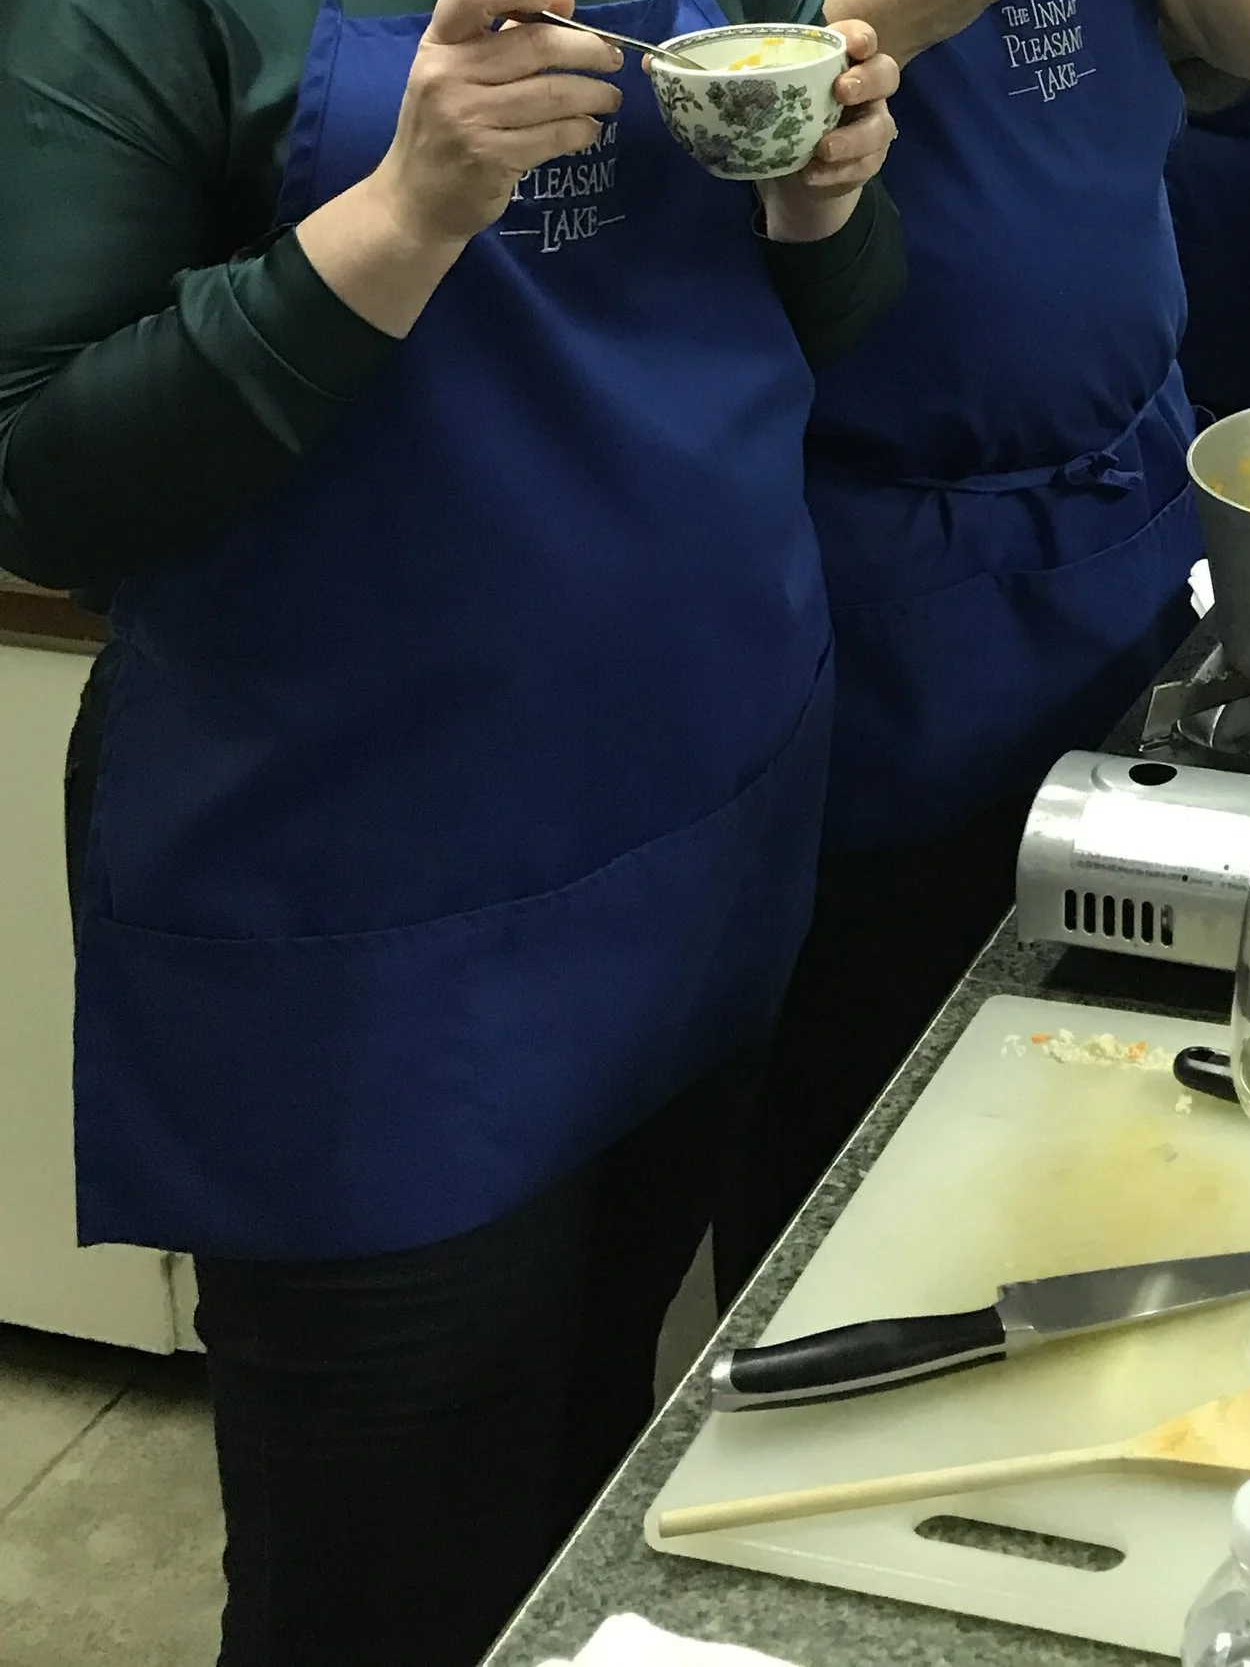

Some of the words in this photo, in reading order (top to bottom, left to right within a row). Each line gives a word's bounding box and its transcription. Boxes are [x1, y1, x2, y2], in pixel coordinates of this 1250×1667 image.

[1001, 5, 1030, 27] THE
[1001, 25, 1084, 68] PLEASANT
[1034, 62, 1079, 103] LAKE
[540, 206, 599, 254] LAKE
